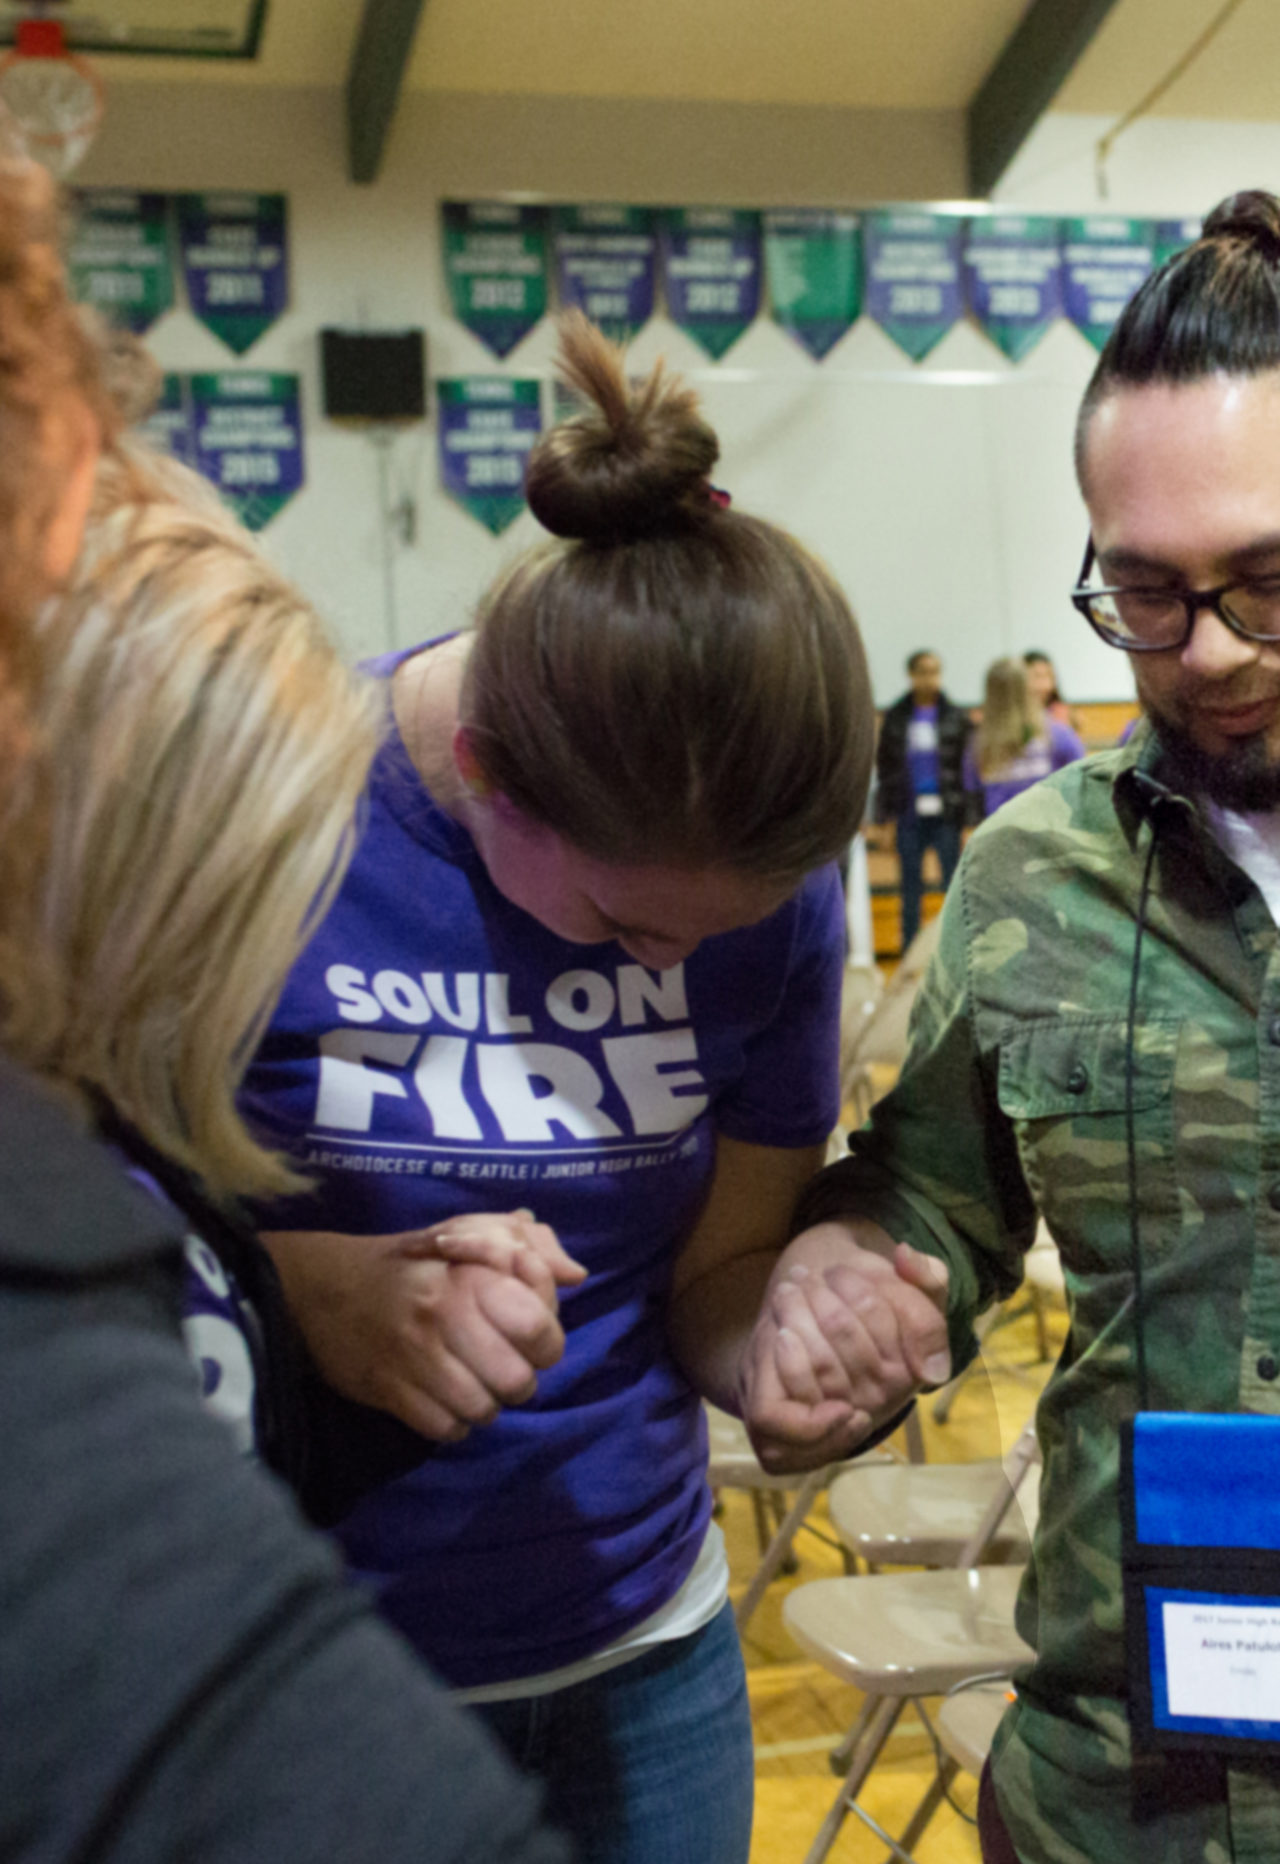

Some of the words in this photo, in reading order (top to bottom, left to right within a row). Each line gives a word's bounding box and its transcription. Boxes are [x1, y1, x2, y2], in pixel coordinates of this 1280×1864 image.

[325, 963, 533, 1036] SOUL
[545, 962, 690, 1032] ON
[313, 1027, 710, 1143] FIRE
[306, 1149, 428, 1176] ARCHDIOCESE
[430, 1160, 454, 1177] OF
[457, 1160, 529, 1180] SEATTLE
[540, 1159, 596, 1180] JUNIOR
[597, 1156, 633, 1174] HIGH
[635, 1151, 678, 1169] RALLY
[1201, 1638, 1232, 1651] Aires
